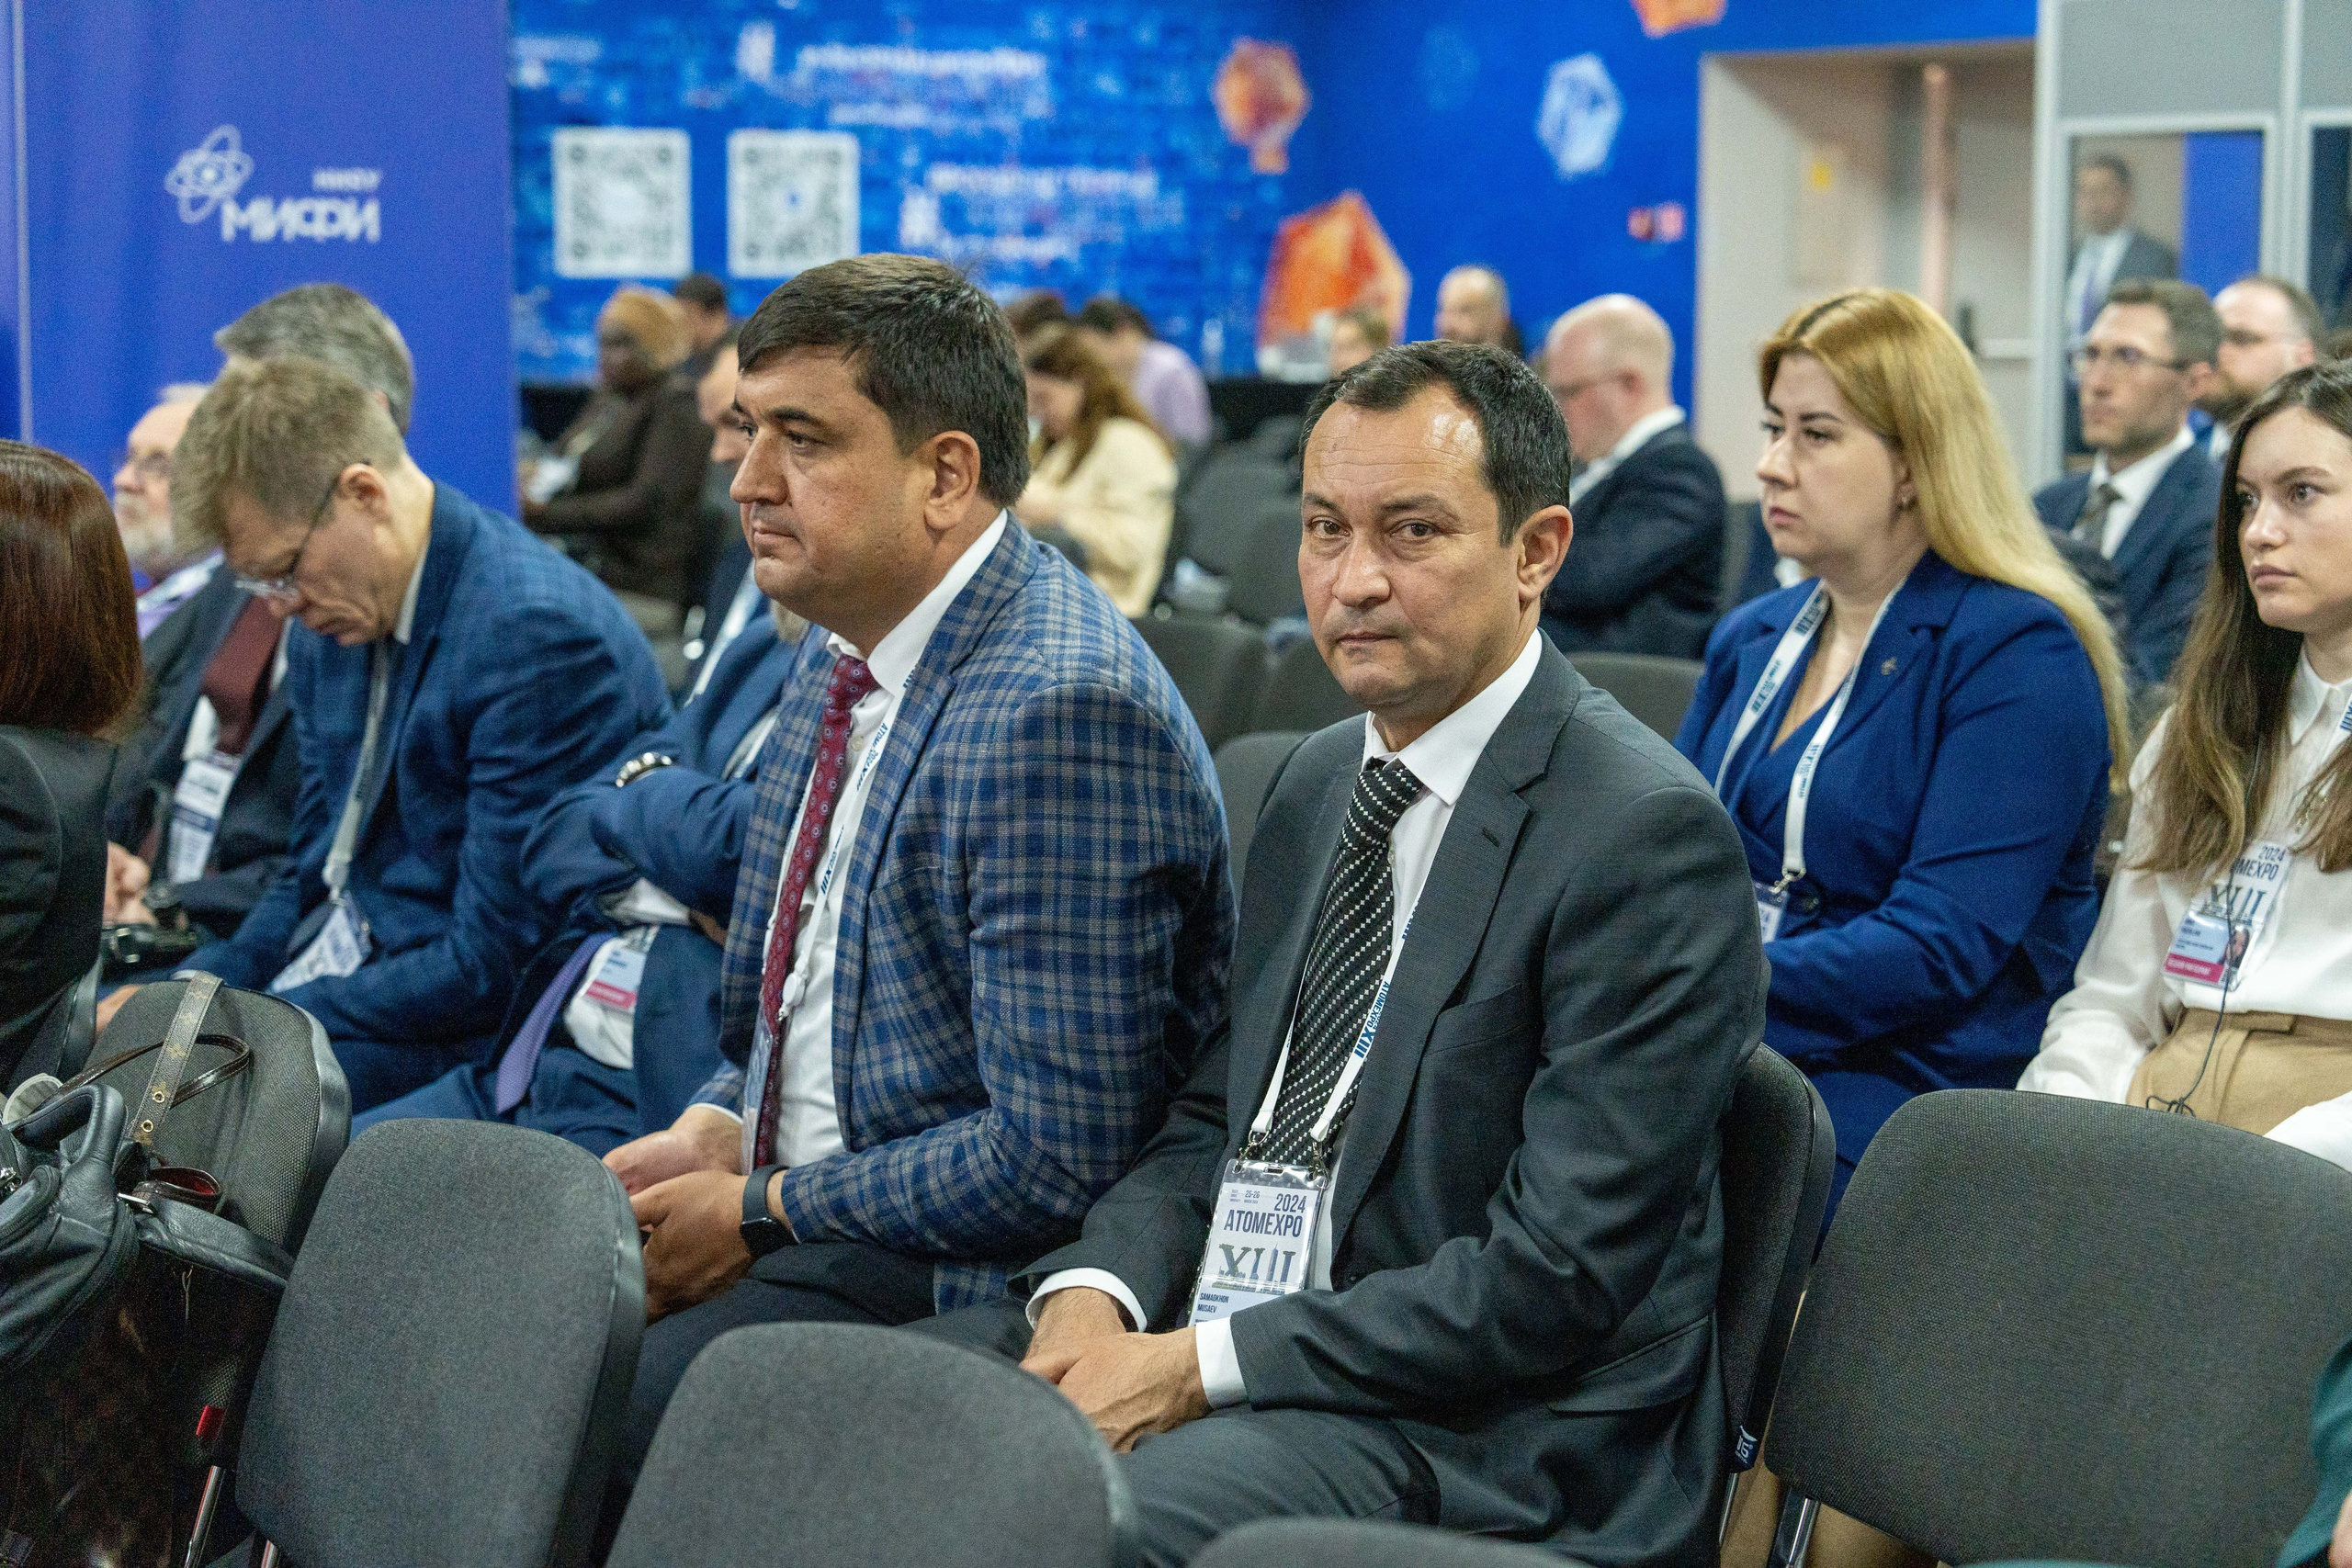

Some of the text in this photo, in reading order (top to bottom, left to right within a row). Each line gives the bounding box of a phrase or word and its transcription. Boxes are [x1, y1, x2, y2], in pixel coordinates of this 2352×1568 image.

[222, 197, 380, 243] МИФИ
[2258, 846, 2286, 862] 2024
[2235, 858, 2279, 881] MEXPO
[1354, 981, 1390, 1058] ATOMEXPO XIII
[1245, 1190, 1261, 1199] 25-26
[1274, 1193, 1306, 1213] 2024
[1224, 1209, 1304, 1237] ATOMEXPO
[1197, 1303, 1217, 1314] MUSAEV
